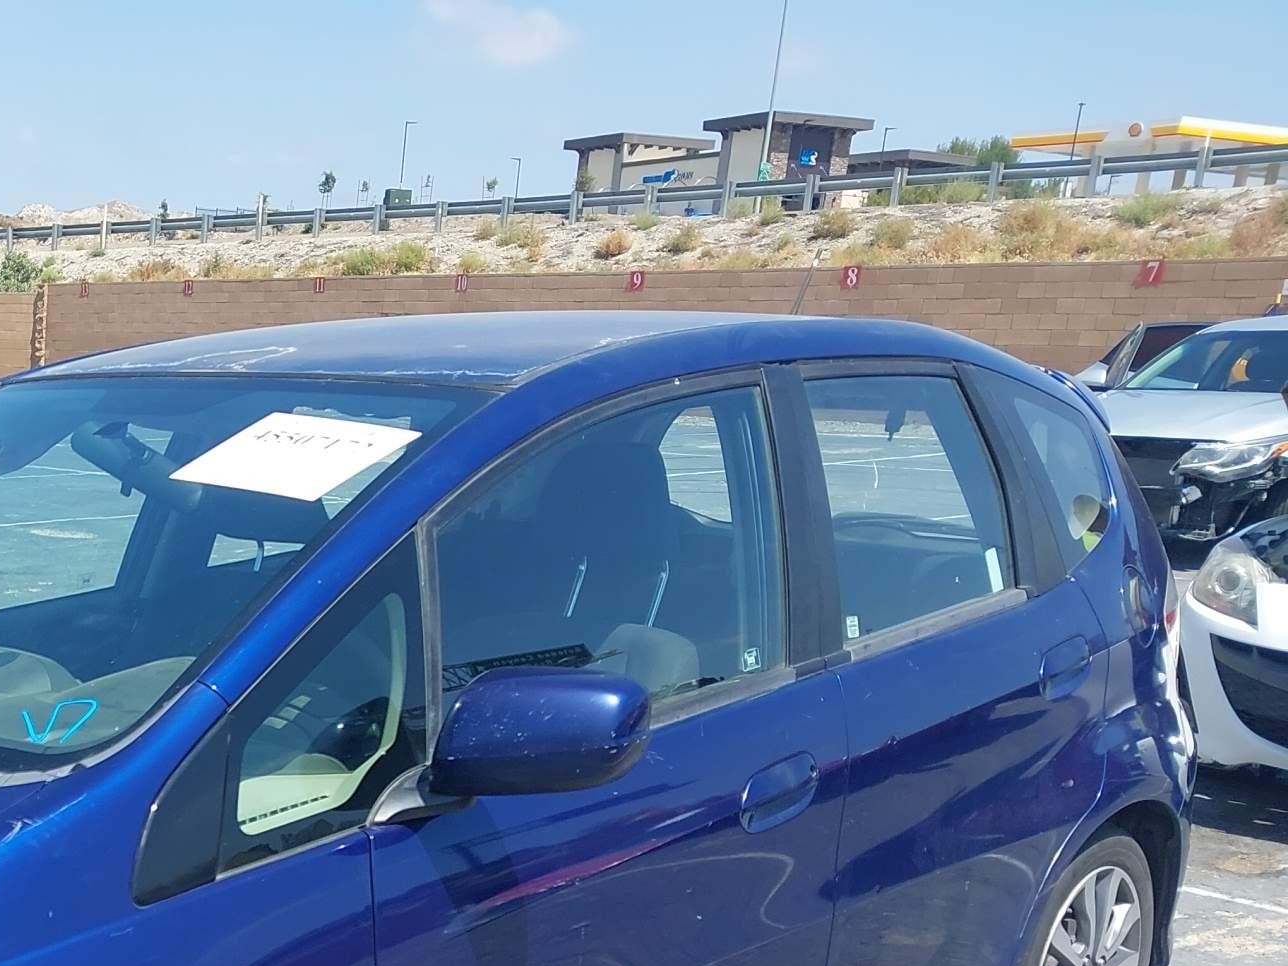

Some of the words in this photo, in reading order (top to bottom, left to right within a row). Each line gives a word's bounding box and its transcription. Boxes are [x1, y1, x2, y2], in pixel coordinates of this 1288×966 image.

[632, 272, 642, 288] 9
[846, 266, 858, 288] 8
[1146, 261, 1160, 282] 7
[316, 277, 324, 292] 11
[456, 274, 467, 291] 10
